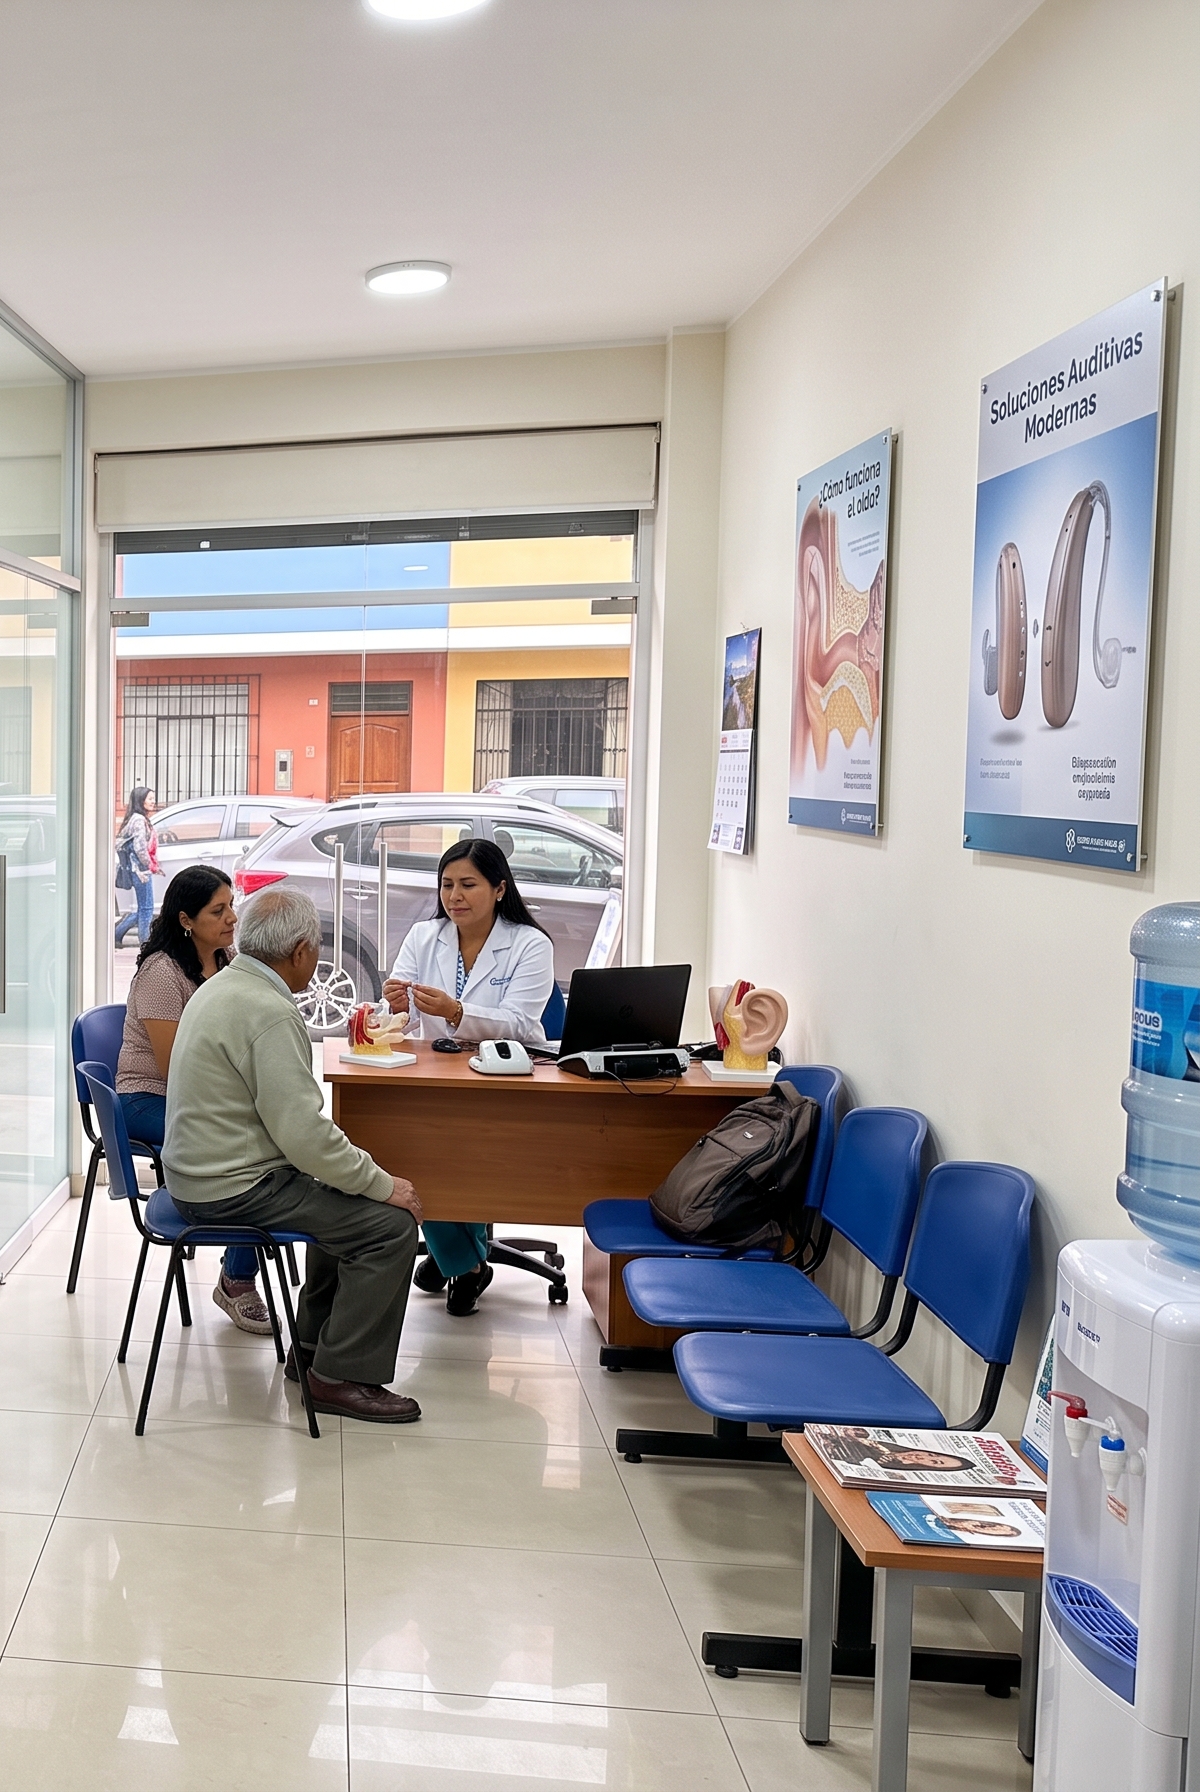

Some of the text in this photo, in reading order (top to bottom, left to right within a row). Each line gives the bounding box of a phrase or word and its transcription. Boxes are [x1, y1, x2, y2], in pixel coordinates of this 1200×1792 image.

[991, 331, 1143, 425] Soluciones Auditivas
[1024, 393, 1097, 443] Modernas
[845, 461, 880, 492] funciona
[848, 496, 856, 518] el
